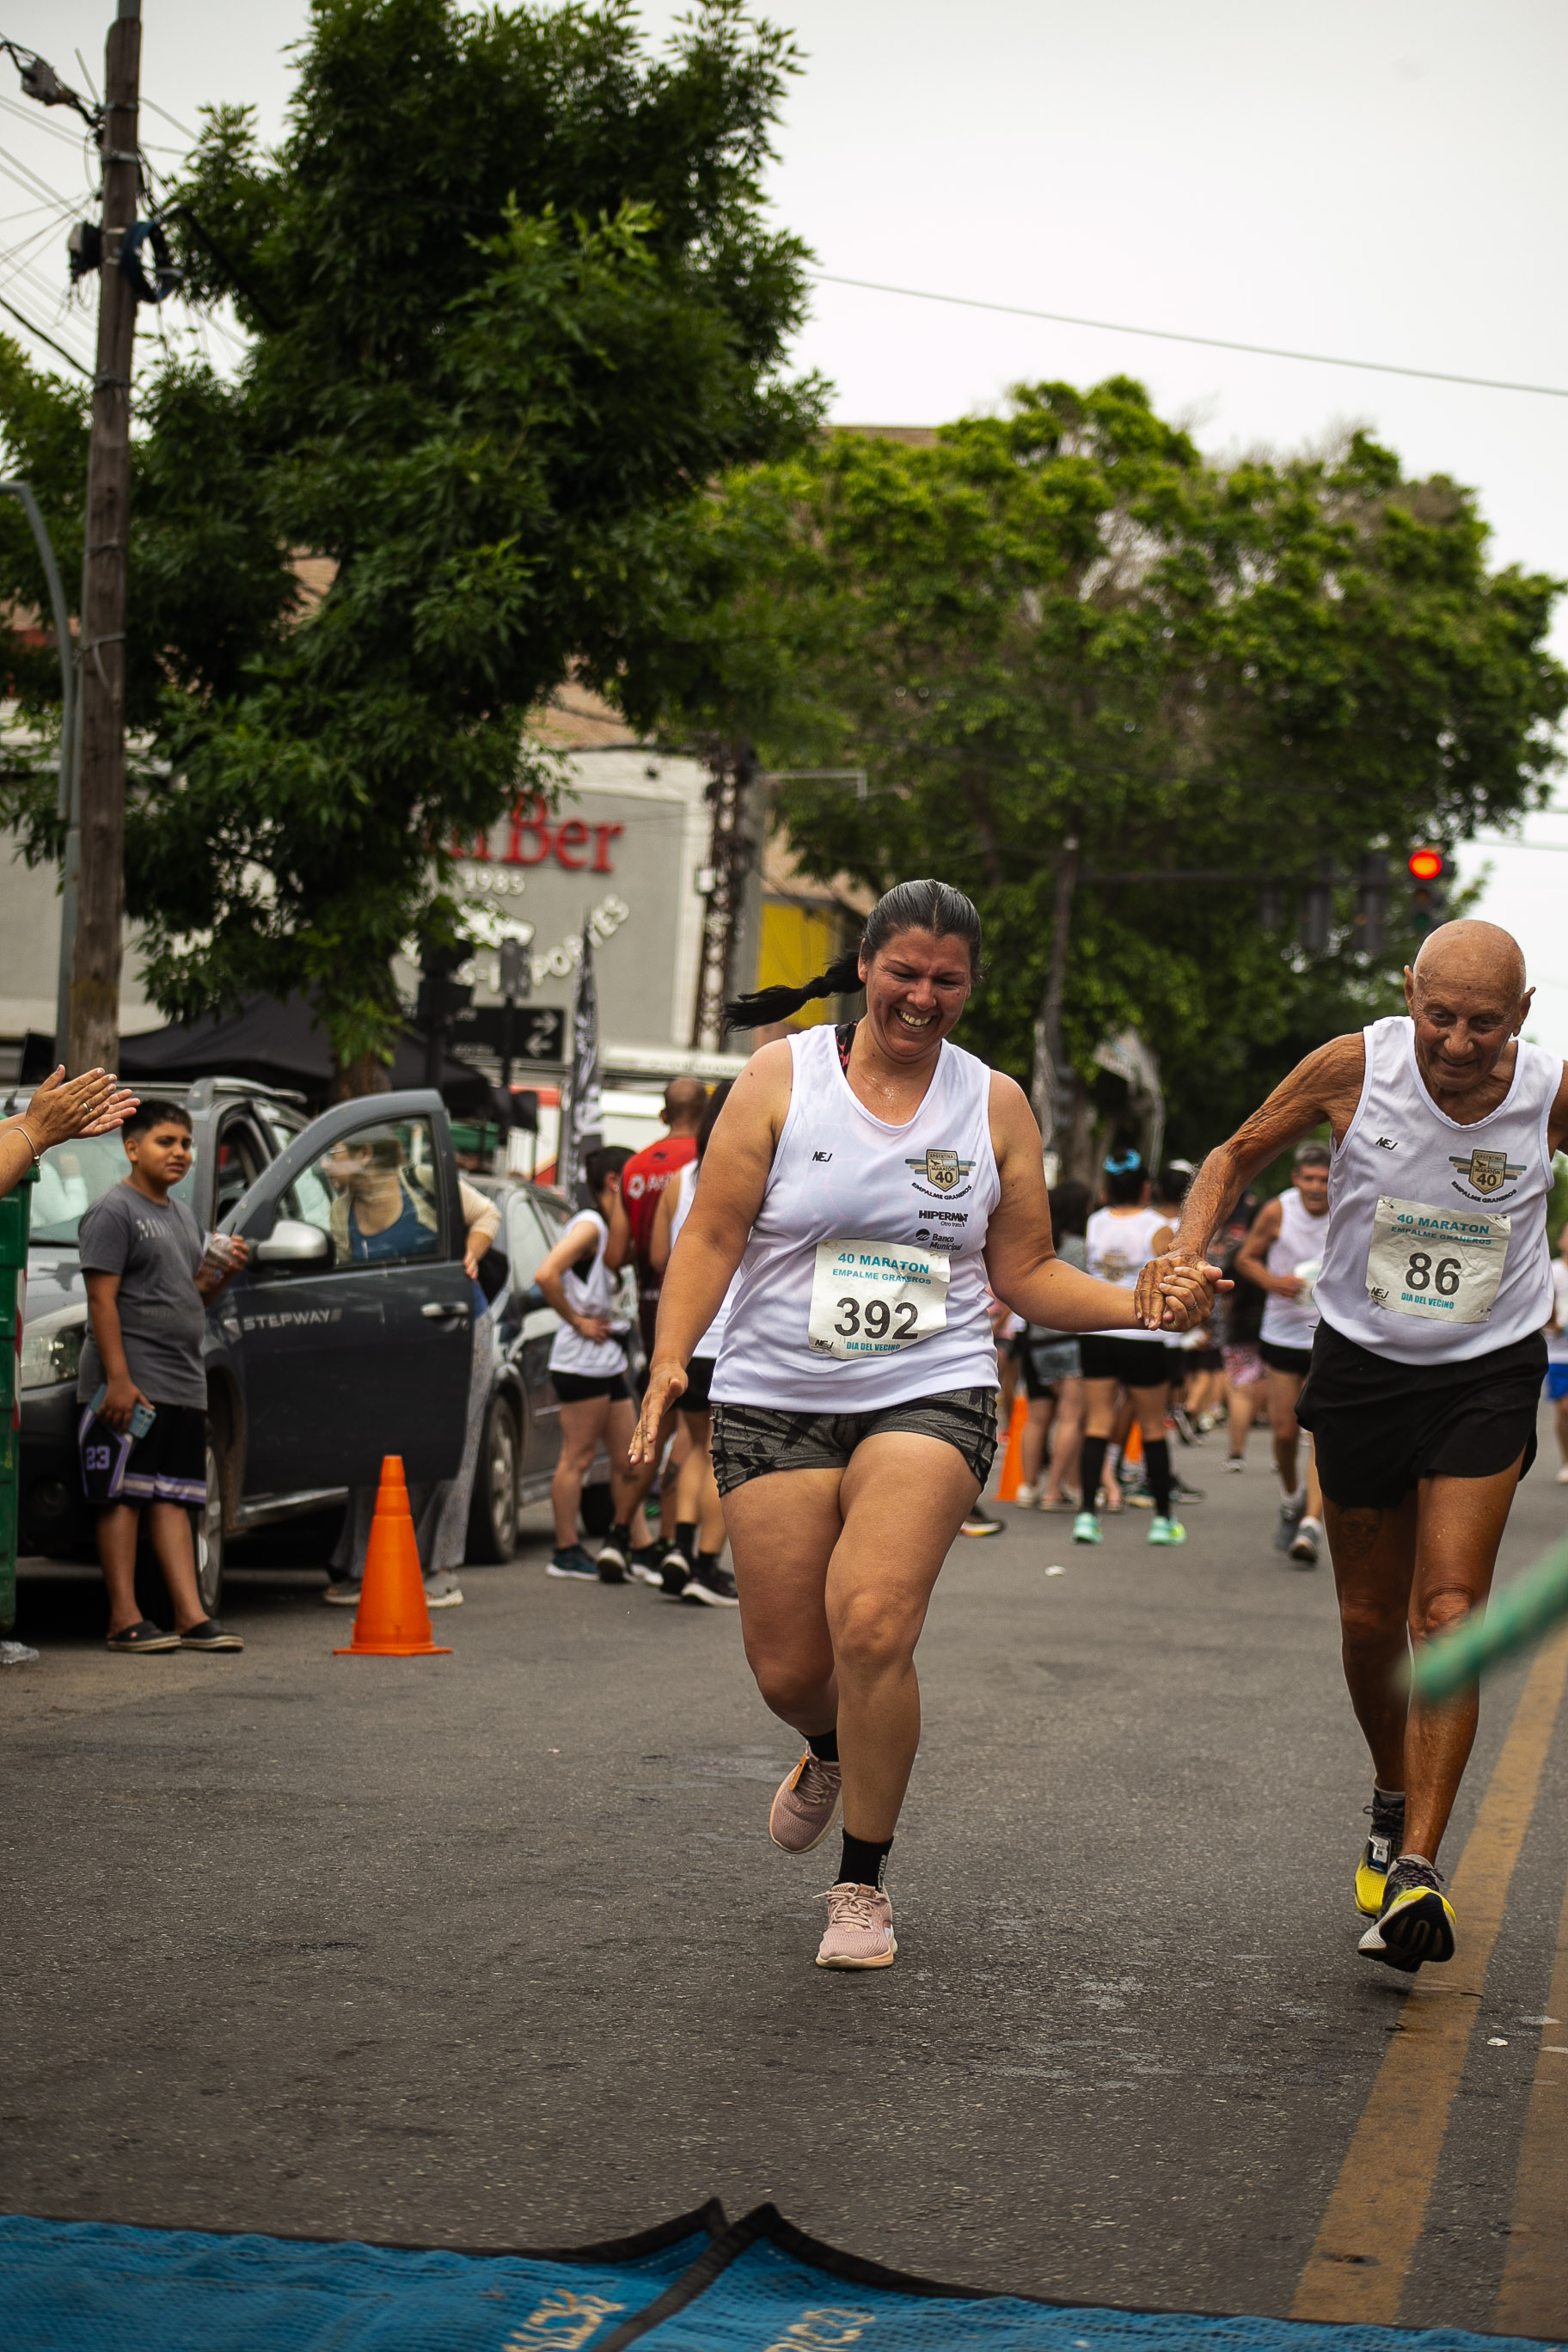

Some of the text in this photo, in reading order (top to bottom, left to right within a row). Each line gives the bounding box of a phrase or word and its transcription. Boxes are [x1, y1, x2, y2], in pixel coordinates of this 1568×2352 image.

[1375, 1136, 1398, 1150] NEJ
[812, 1151, 832, 1162] NEJ
[934, 1171, 953, 1184] 40
[1476, 1173, 1498, 1186] 40
[911, 1182, 972, 1200] EMPALME GRANEROS
[1451, 1180, 1517, 1204] EMPALME GRANEROS
[1397, 1214, 1490, 1234] 40 MARATON
[932, 1234, 954, 1242] Banco
[1391, 1226, 1491, 1246] EMPALME GRANEROS
[929, 1241, 963, 1251] Municipal
[837, 1253, 929, 1274] 40 MARATON
[832, 1268, 879, 1280] EMPALME
[1405, 1252, 1461, 1295] 86
[1371, 1287, 1389, 1299] NEJ
[1401, 1292, 1455, 1309] DIA DEL VECINO
[243, 1308, 330, 1331] STEPWAY
[834, 1297, 919, 1340] 392
[815, 1339, 835, 1349] NEJ
[846, 1341, 860, 1351] DIA
[861, 1342, 873, 1351] DEL
[86, 1445, 111, 1470] 23
